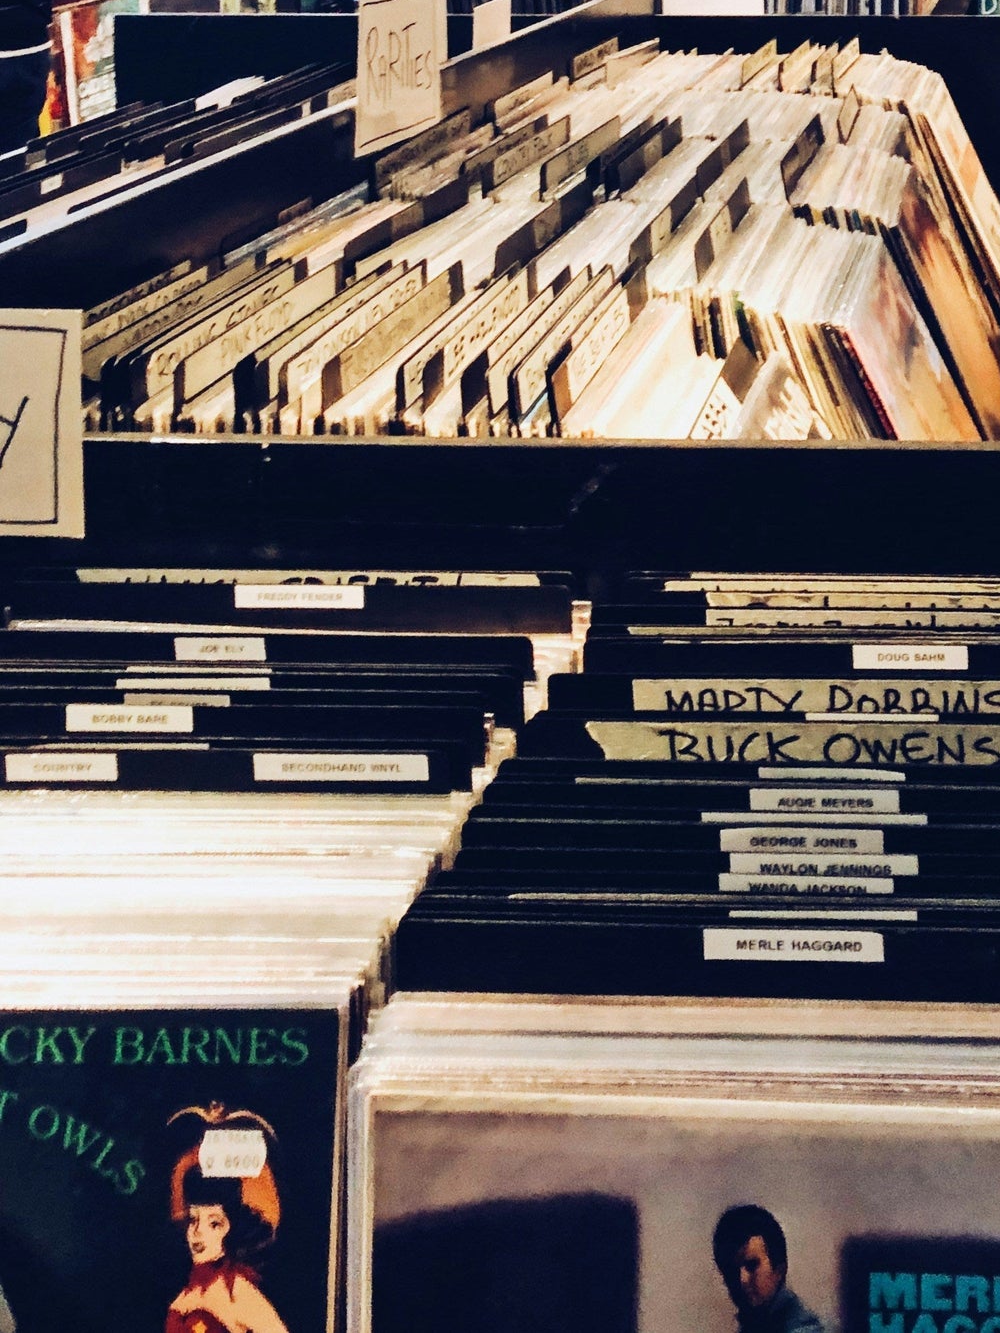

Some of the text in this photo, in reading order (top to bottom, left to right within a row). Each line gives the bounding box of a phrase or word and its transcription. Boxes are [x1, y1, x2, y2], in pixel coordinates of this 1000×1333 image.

[877, 652, 910, 662] DOUG
[92, 714, 132, 724] BOBBY
[657, 728, 802, 764] BUCK
[281, 762, 366, 773] SECONDHAND
[778, 797, 874, 808] AUGIE MEYERS
[749, 836, 858, 849] GEORGE JONES
[760, 863, 892, 876] WAYLON JENNINGS
[736, 940, 863, 952] MERLE HAGGARD
[0, 1026, 310, 1065] CKY BARNES
[28, 1105, 147, 1196] OWLS
